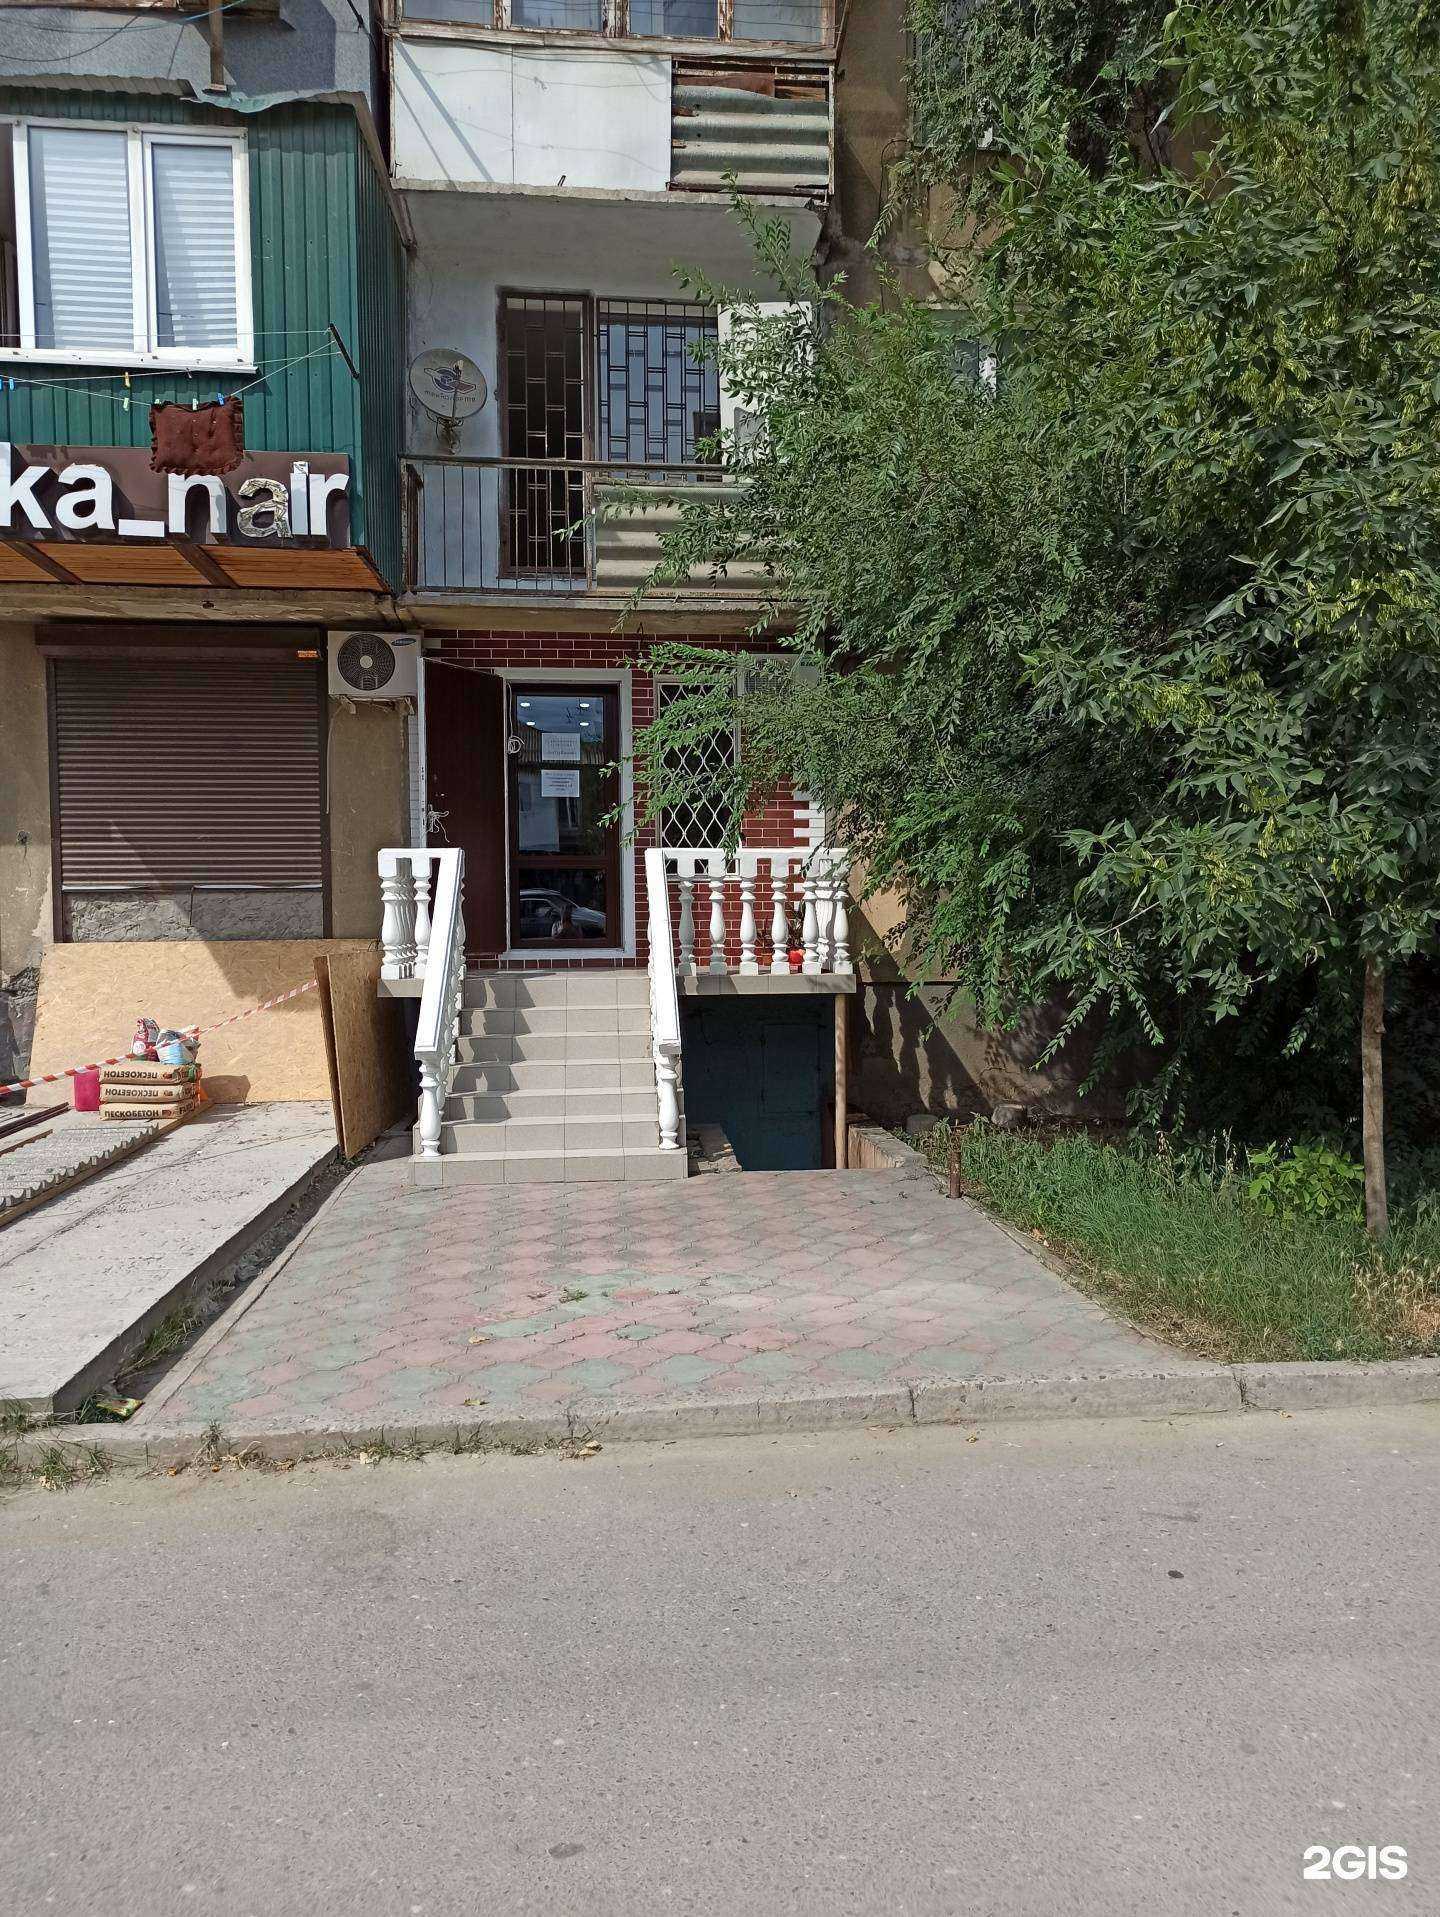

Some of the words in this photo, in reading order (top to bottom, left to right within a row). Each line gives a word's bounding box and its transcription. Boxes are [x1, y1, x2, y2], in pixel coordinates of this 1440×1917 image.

[103, 1070, 158, 1079] ПЕСКОБЕТОН
[105, 1088, 159, 1097] ПЕСКОБЕТОН
[104, 1109, 159, 1118] ПЕСКОБЕТОН
